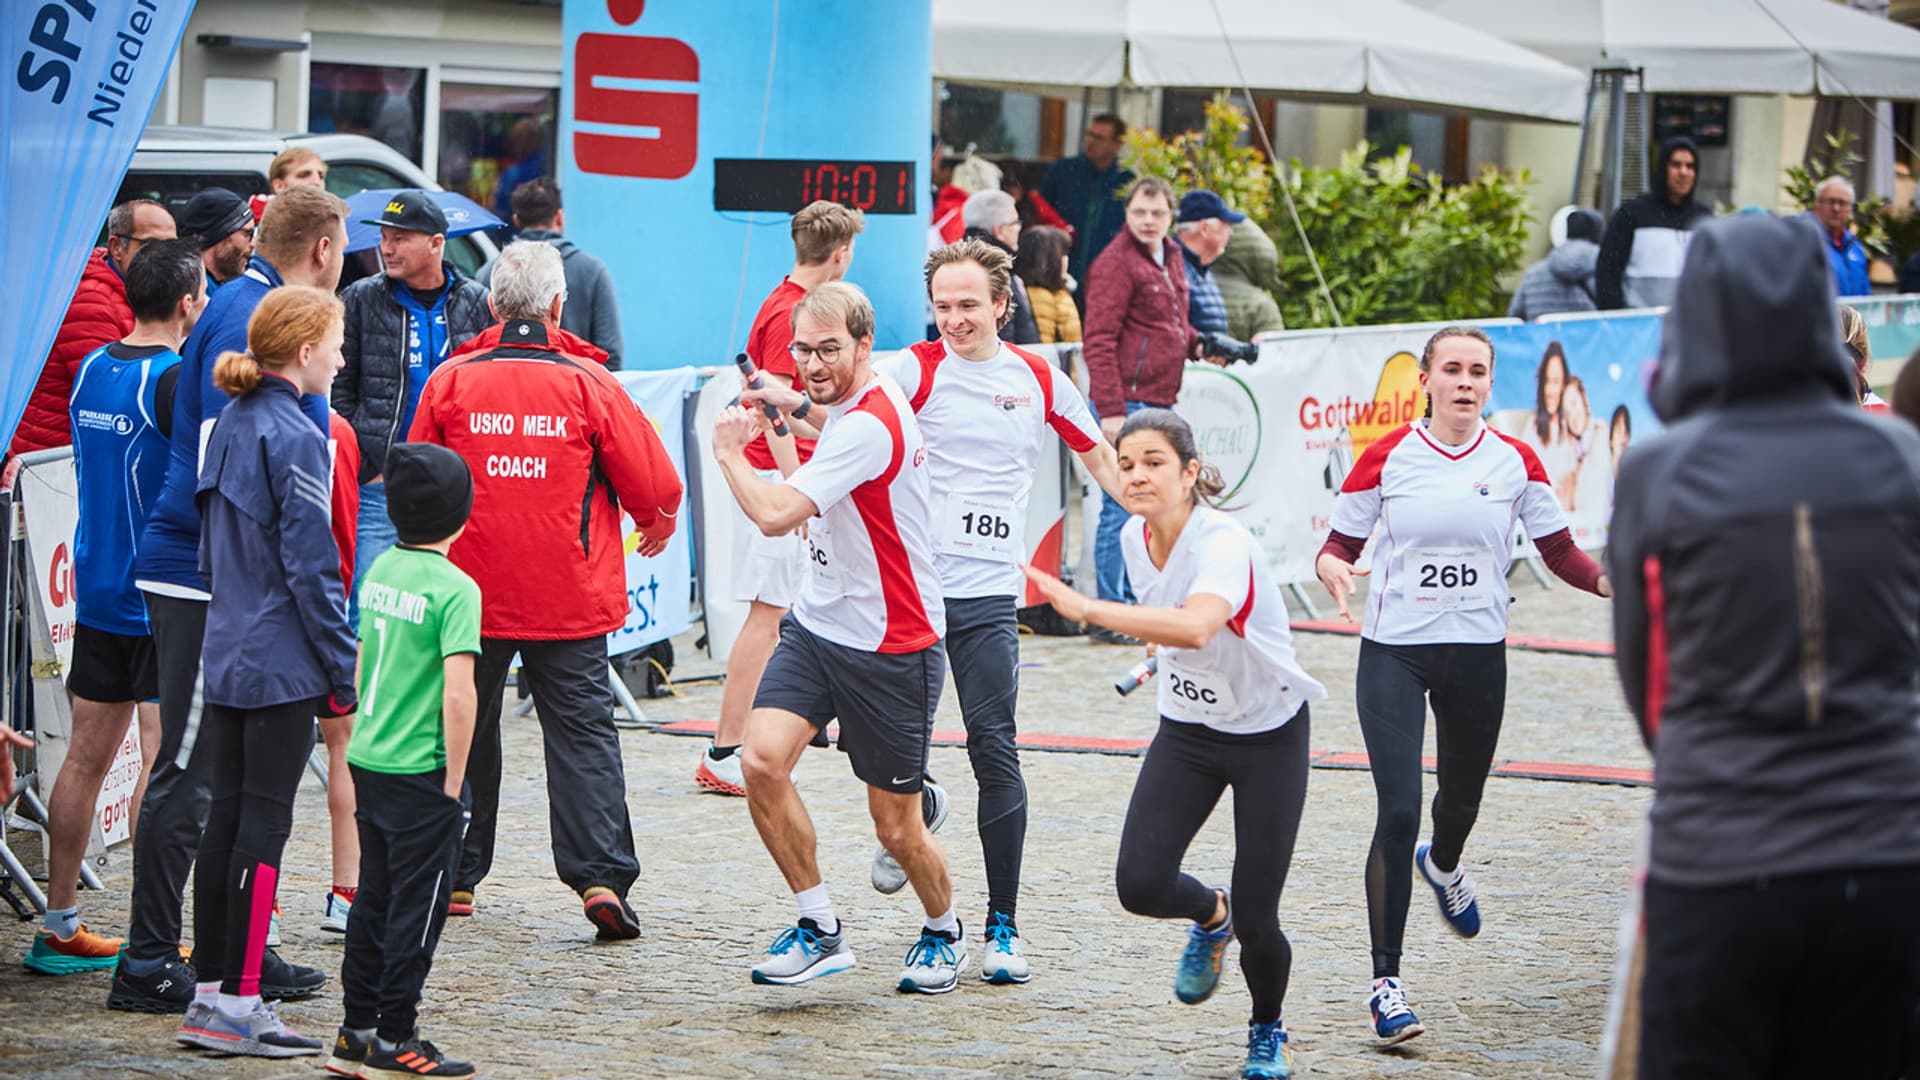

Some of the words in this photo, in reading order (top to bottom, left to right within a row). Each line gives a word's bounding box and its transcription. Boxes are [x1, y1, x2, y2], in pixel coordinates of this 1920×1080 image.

[17, 0, 97, 105] SP
[1299, 390, 1418, 430] Gottwald
[470, 413, 514, 435] USKO
[523, 415, 568, 438] MELK
[486, 455, 546, 479] COACH
[962, 512, 1011, 540] 18b
[1420, 563, 1478, 588] 26b
[1170, 673, 1218, 704] 26c
